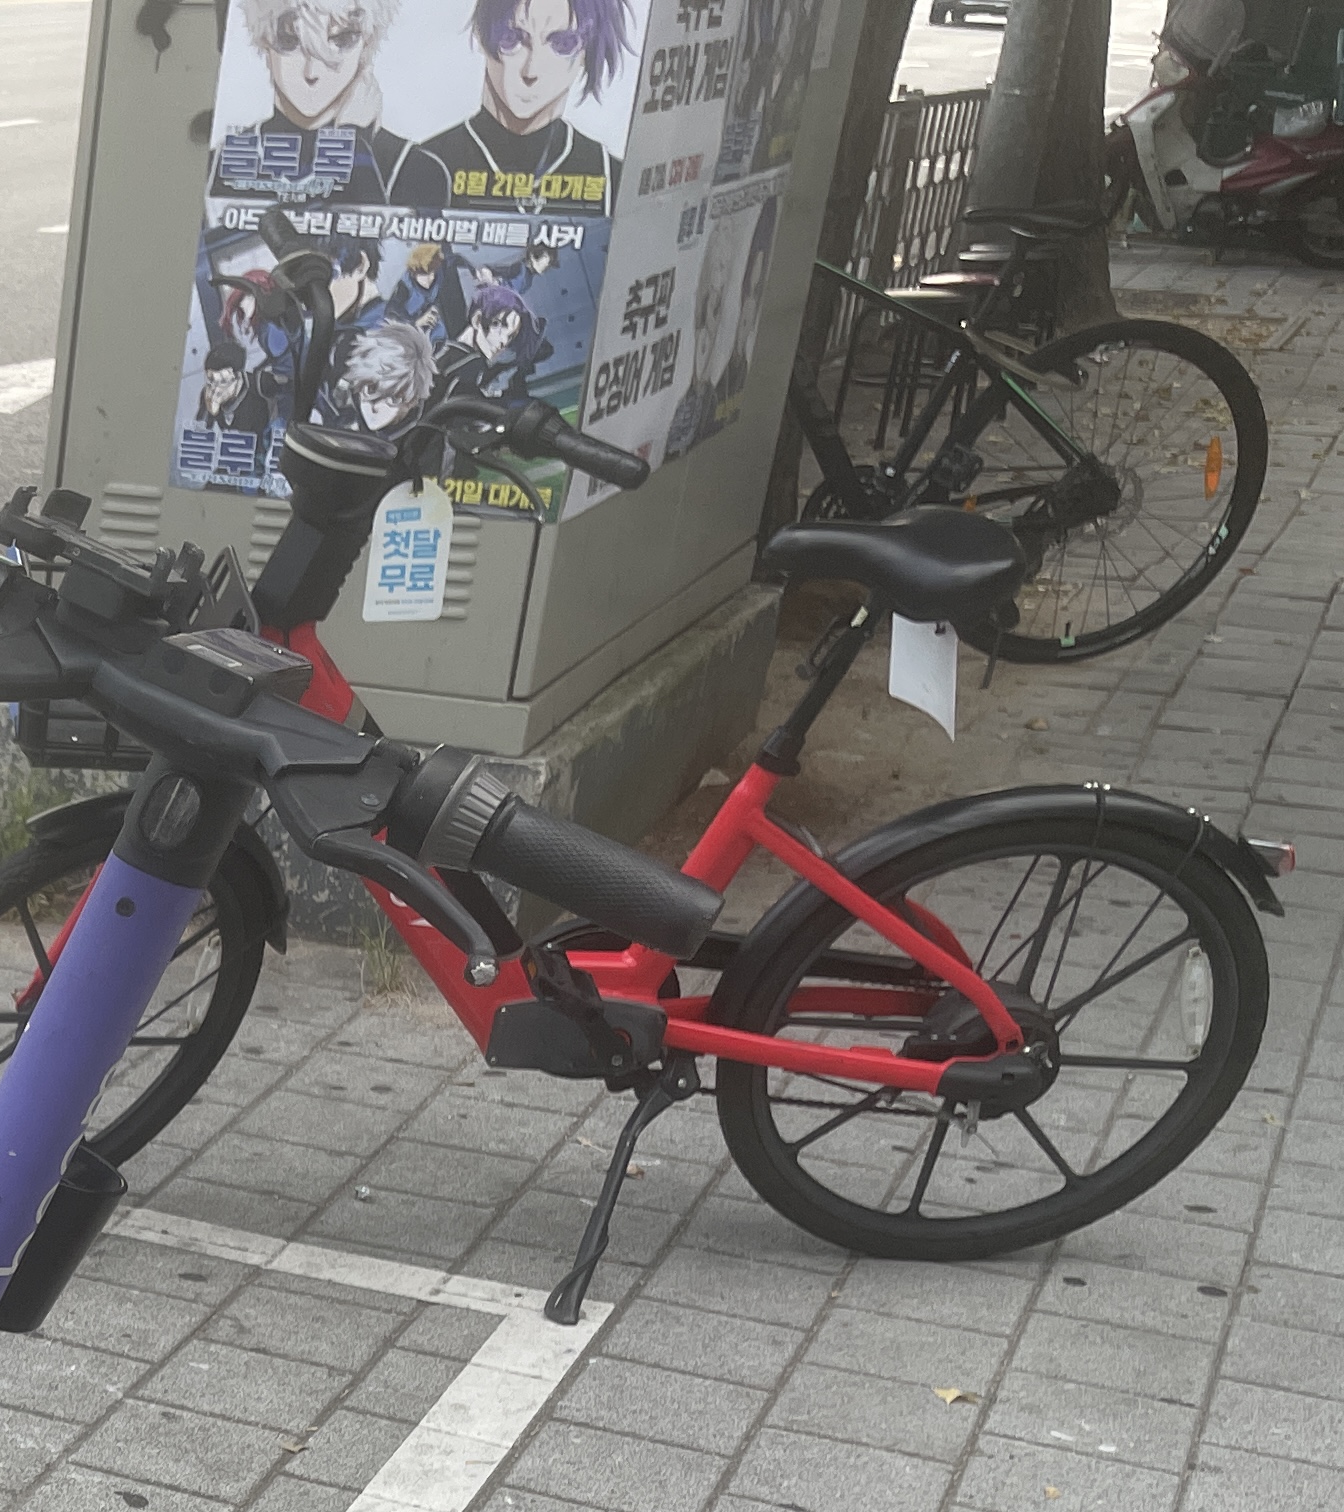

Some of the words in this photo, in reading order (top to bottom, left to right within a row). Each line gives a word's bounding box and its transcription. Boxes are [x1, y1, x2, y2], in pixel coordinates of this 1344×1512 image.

[219, 133, 302, 181] 블루
[453, 170, 488, 197] 8월
[492, 172, 534, 199] 21일
[540, 174, 606, 201] 대개봉
[223, 205, 332, 236] 아드날린
[336, 213, 383, 239] 폭발
[386, 215, 478, 244] 서바이벌
[482, 221, 530, 246] 배틀
[533, 223, 585, 249] 사커
[588, 343, 647, 425] 오징어
[382, 528, 442, 560] 첫달
[377, 563, 435, 594] 무료
